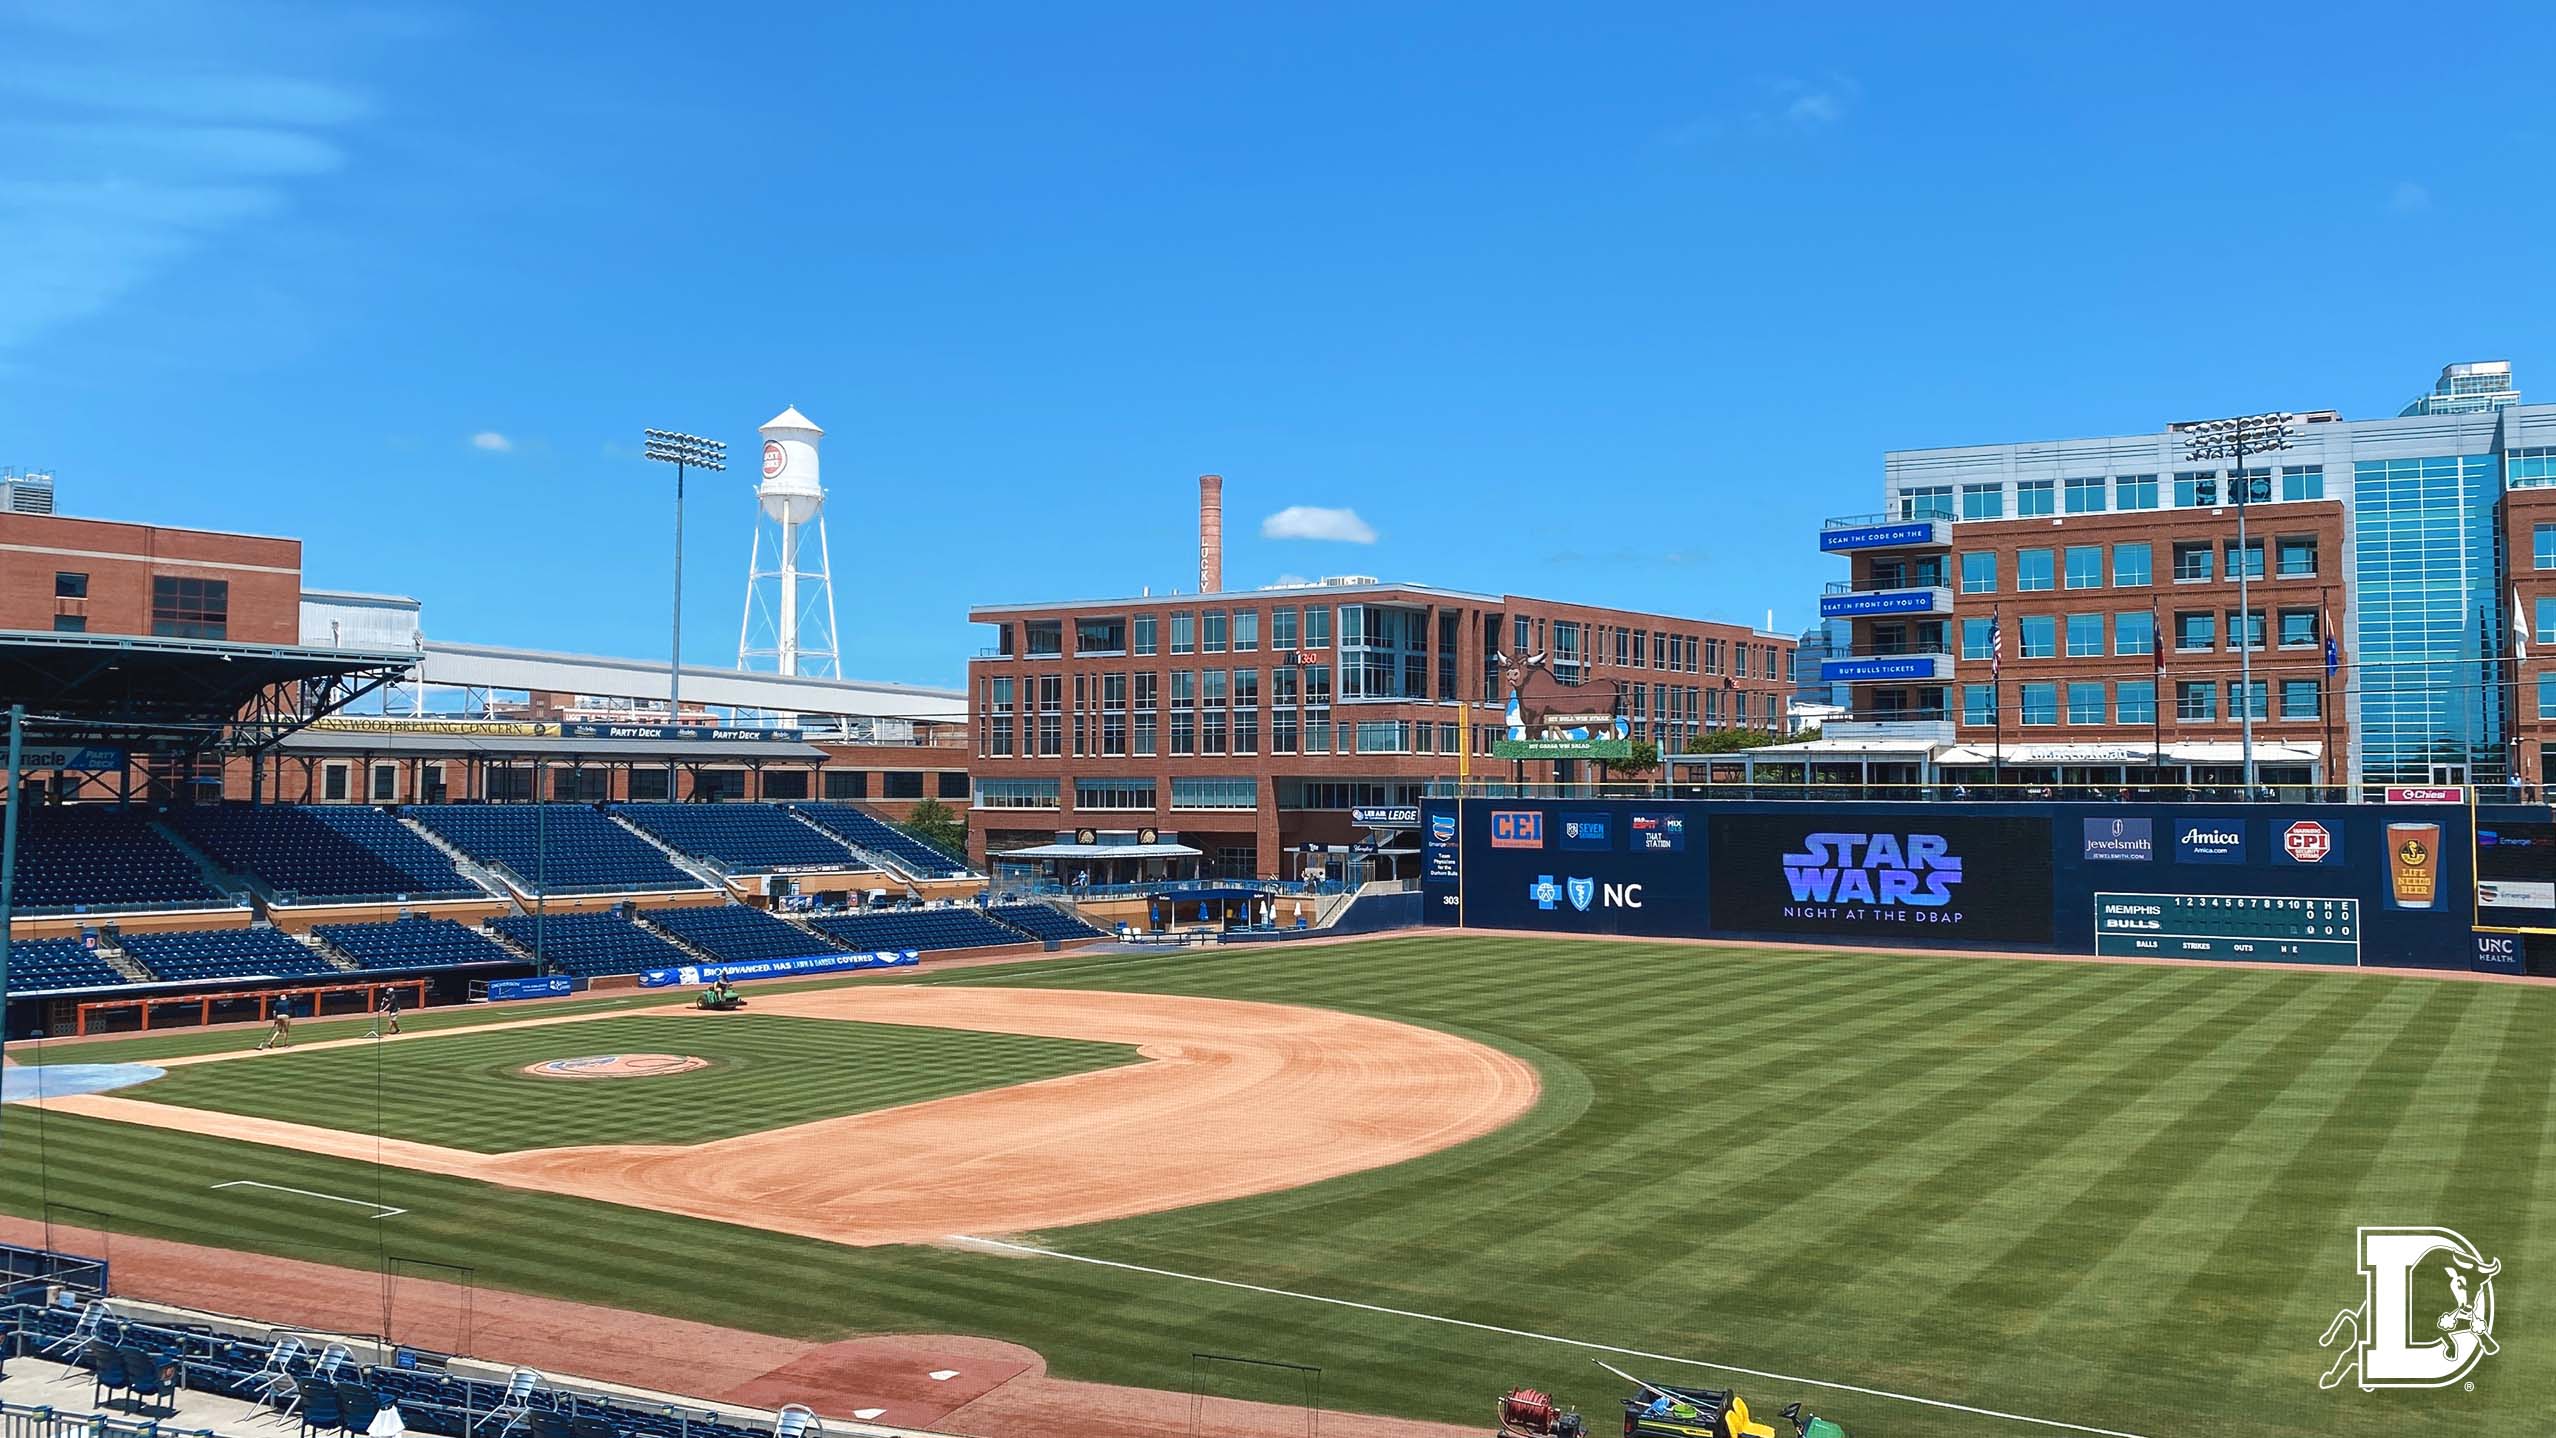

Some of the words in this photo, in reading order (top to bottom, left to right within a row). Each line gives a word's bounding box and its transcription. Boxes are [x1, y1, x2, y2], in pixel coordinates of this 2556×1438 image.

[1200, 536, 1209, 593] LUCKY
[1855, 601, 1880, 609] FRONT
[1882, 665, 1915, 673] TICKETS
[394, 720, 458, 734] BREWING
[460, 722, 523, 735] CONCERN
[610, 727, 637, 737] PARTY
[638, 728, 661, 738] DECK
[712, 730, 738, 740] PARTY
[739, 731, 760, 740] DECK
[2414, 789, 2446, 799] Chiesi
[1388, 810, 1417, 820] LEDGE
[1493, 814, 1541, 840] CEI
[1578, 823, 1604, 833] SEVEN
[1645, 832, 1662, 840] THAT
[2181, 828, 2240, 844] Amica
[2288, 835, 2326, 848] CPI
[1645, 840, 1671, 848] STATION
[1783, 833, 1963, 870] STAR
[2401, 868, 2426, 877] LIFE
[1783, 867, 1963, 906] WARS
[2398, 877, 2431, 886] NEEDS
[1604, 883, 1642, 908] NC
[2401, 886, 2428, 894] BEER
[1443, 896, 1459, 905] 303
[2174, 897, 2181, 906] 1
[2187, 898, 2194, 906] 2
[2199, 898, 2206, 906] 3
[2212, 899, 2219, 907] 4
[2225, 899, 2232, 907] 5
[2238, 899, 2244, 908] 6
[2250, 900, 2257, 908] 7
[2264, 900, 2271, 908] 8
[2277, 900, 2284, 908] 9
[2288, 900, 2301, 909] 10
[2306, 901, 2314, 910] R
[2324, 901, 2332, 910] H
[2341, 902, 2349, 910] E
[1784, 907, 1838, 919] NIGHT
[1846, 909, 1865, 919] AT
[1873, 910, 1906, 921] THE
[1916, 911, 1963, 923] DBAP
[2105, 905, 2161, 915] MEMPHIS
[2306, 911, 2314, 919] 0
[2325, 911, 2332, 919] 0
[2341, 911, 2349, 920] 0
[2106, 919, 2161, 929] BULLS
[2307, 925, 2315, 934] 0
[2325, 926, 2333, 935] 0
[2342, 926, 2350, 935] 0
[2136, 940, 2159, 948] BALLS
[2182, 942, 2211, 950] STRIKES
[2233, 944, 2254, 952] OUTS
[2478, 938, 2513, 953] UNC
[773, 961, 792, 970] HAS
[837, 954, 874, 964] COVERED
[2479, 954, 2513, 962] HEALTH
